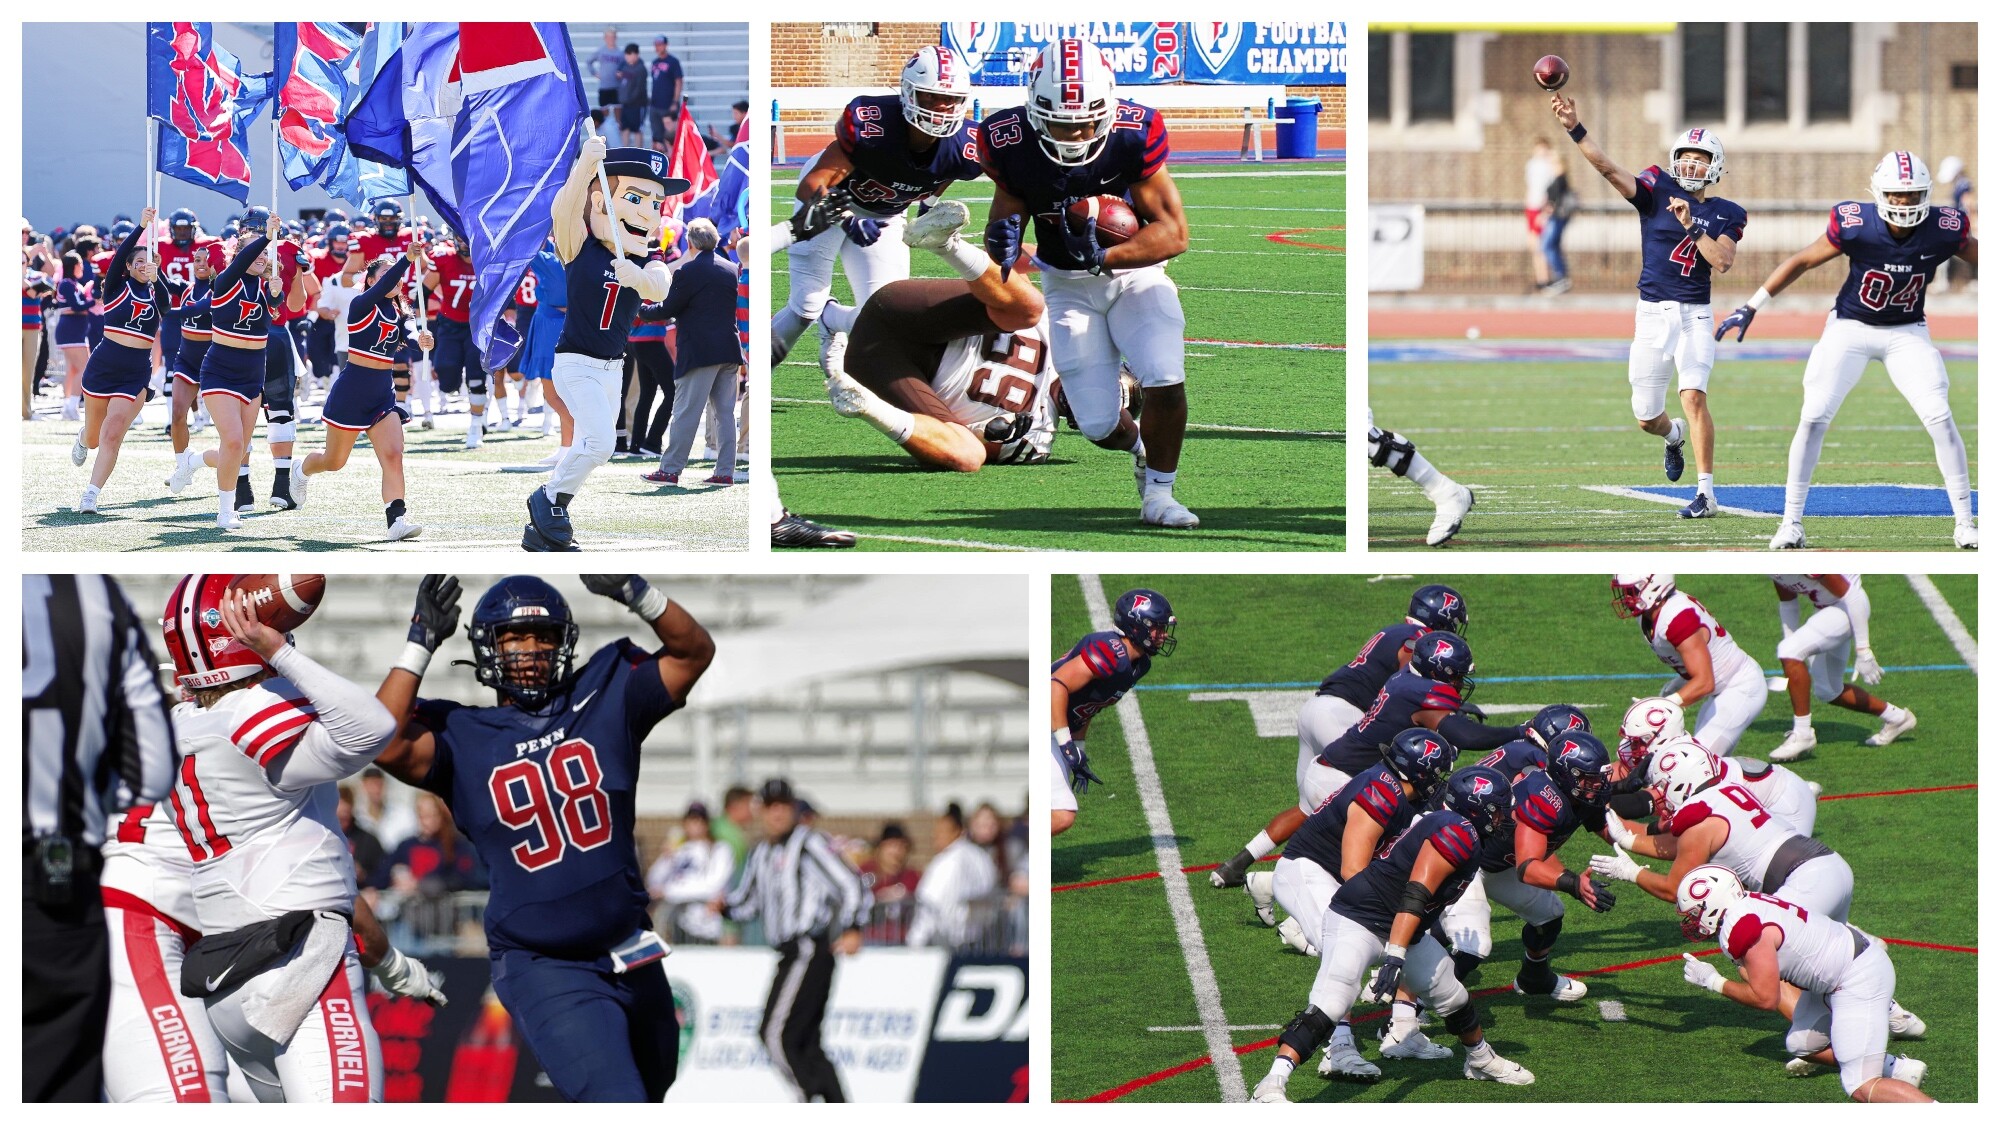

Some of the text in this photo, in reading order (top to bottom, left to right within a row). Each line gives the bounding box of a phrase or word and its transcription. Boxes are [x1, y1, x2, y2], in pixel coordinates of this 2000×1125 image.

[856, 105, 884, 139] 84
[988, 113, 1022, 149] 13
[1112, 104, 1146, 133] 13
[890, 181, 923, 192] PENN
[1690, 216, 1710, 228] ENN
[1838, 203, 1863, 228] 84
[1938, 206, 1961, 231] 84
[1669, 228, 1706, 277] 4
[1884, 263, 1913, 273] PENN
[600, 281, 621, 331] 1
[1858, 269, 1926, 313] 84
[125, 299, 155, 331] P
[233, 299, 263, 331] P
[369, 320, 400, 355] P
[184, 670, 230, 688] BIG RED
[1646, 709, 1667, 727] C
[515, 727, 566, 758] PENN
[1659, 753, 1677, 773] C
[169, 753, 233, 863] 11
[488, 737, 613, 873] 98
[1540, 785, 1563, 813] 58
[1688, 879, 1712, 900] C
[152, 1004, 202, 1096] CORNELL
[325, 998, 366, 1092] CORNELL
